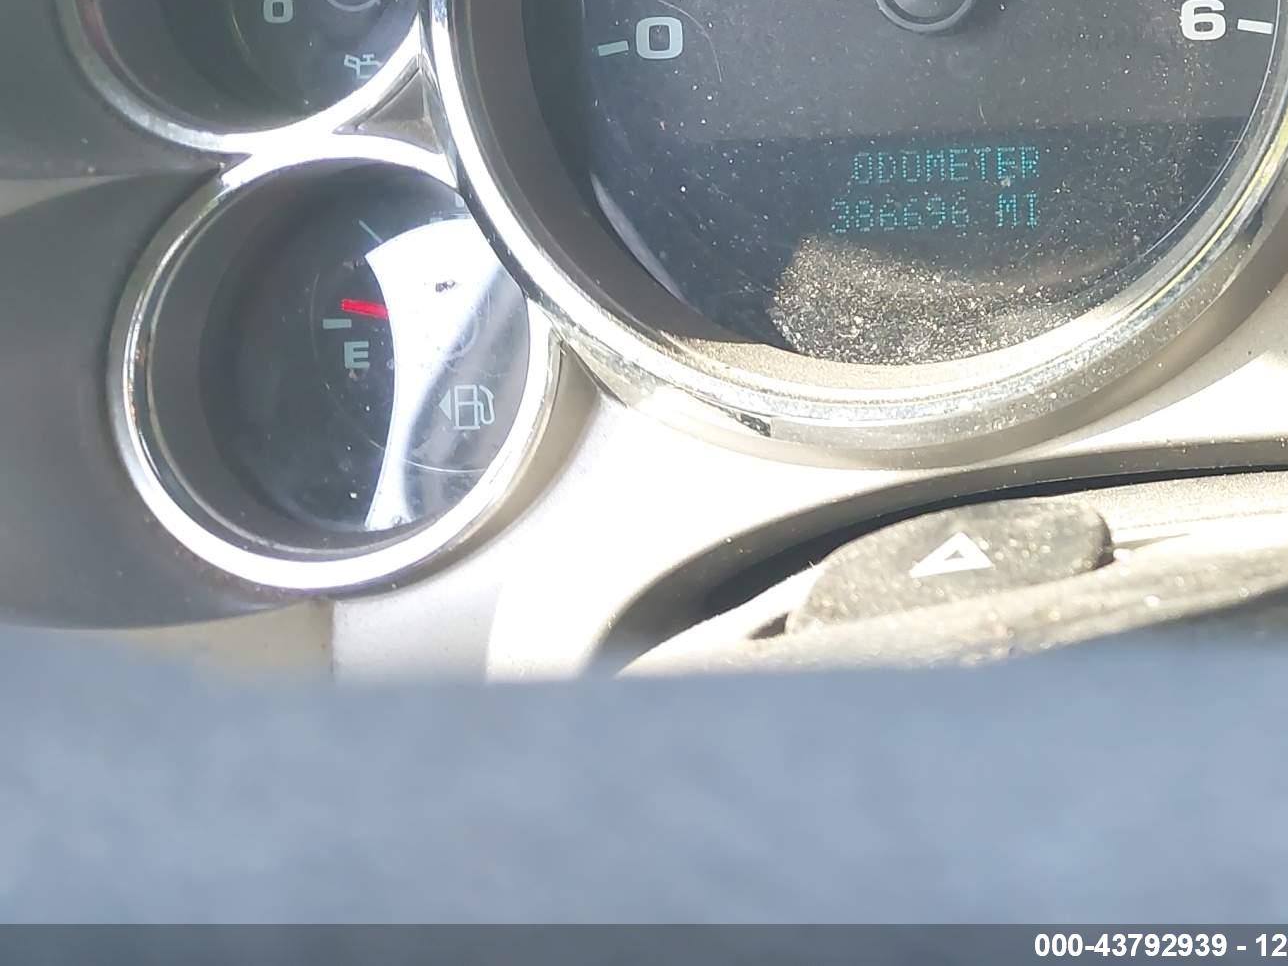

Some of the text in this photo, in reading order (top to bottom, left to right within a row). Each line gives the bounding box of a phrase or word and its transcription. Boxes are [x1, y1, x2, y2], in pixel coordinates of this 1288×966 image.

[635, 17, 683, 60] 0
[854, 147, 1040, 184] ODOMETER
[996, 193, 1038, 227] MI
[344, 341, 370, 368] E
